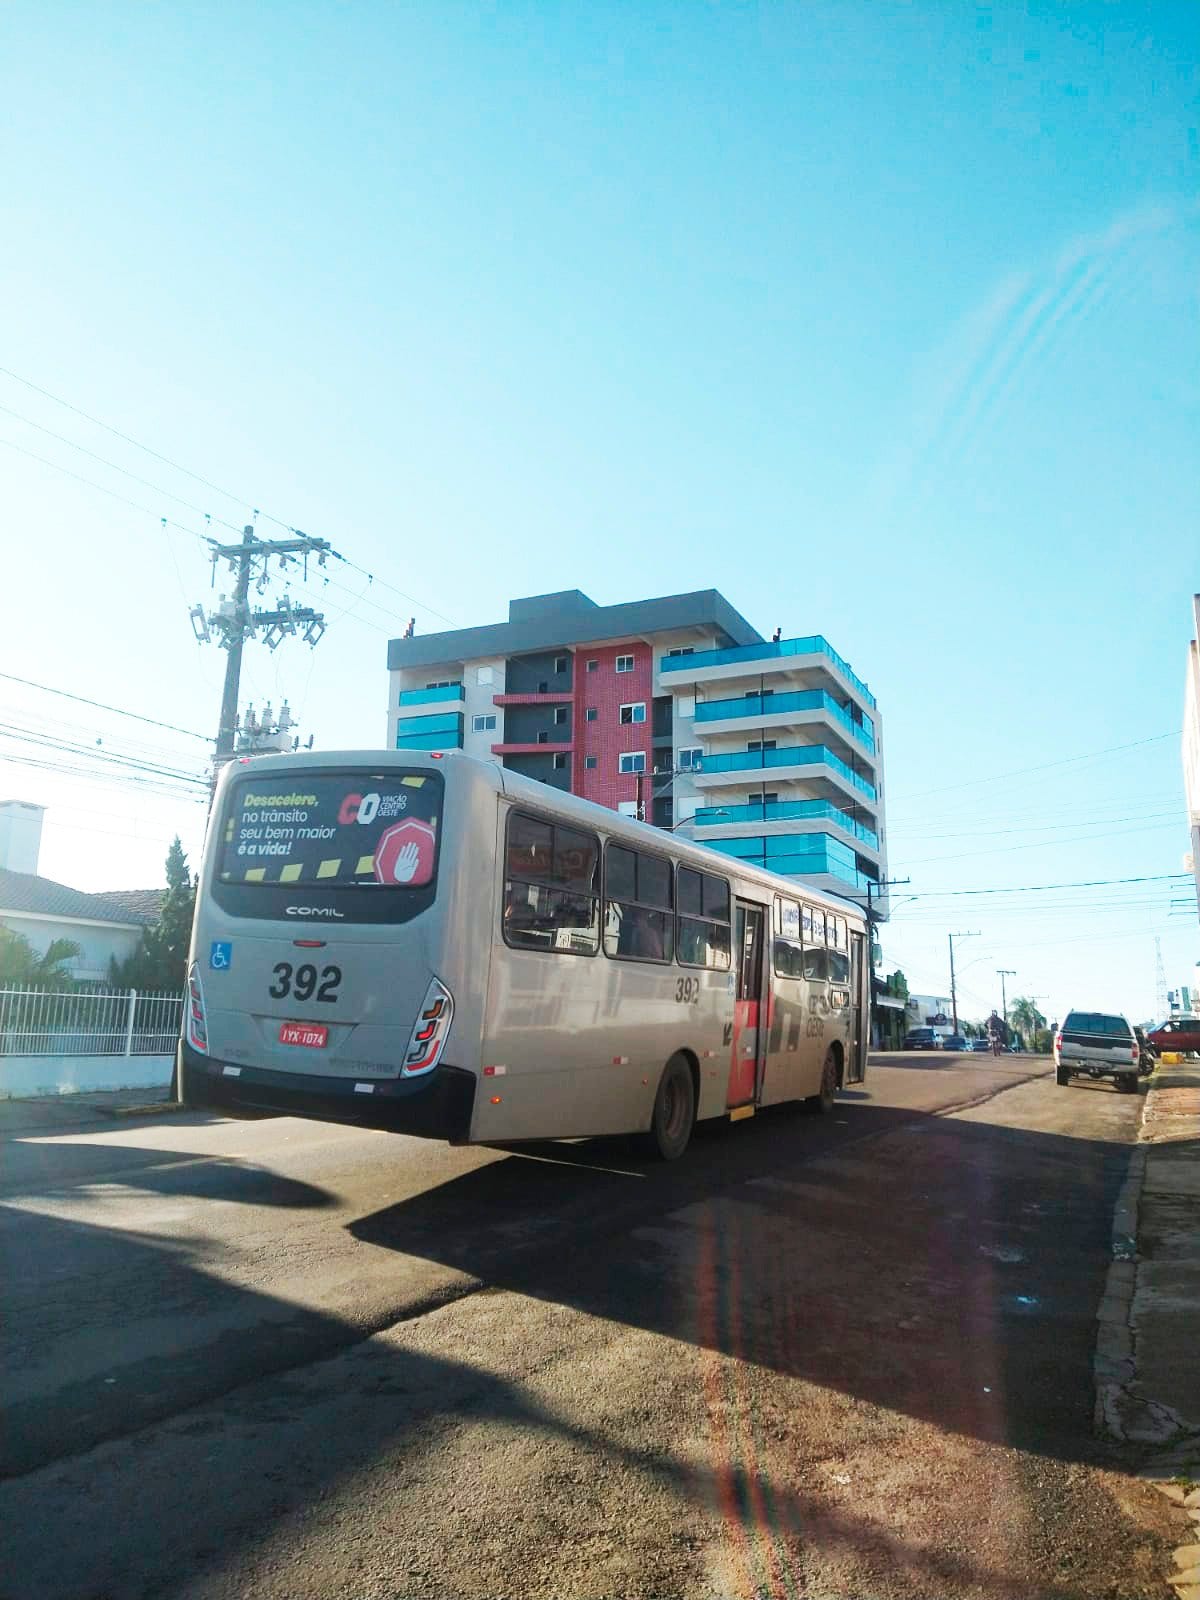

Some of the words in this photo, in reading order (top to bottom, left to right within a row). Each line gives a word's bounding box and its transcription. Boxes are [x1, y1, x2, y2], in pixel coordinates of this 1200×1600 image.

[243, 793, 319, 808] Desacelere,
[380, 801, 407, 811] CENTRO
[242, 811, 259, 823] no
[261, 808, 308, 823] trânsito
[377, 809, 398, 817] OESTE
[240, 828, 263, 840] seu
[265, 826, 293, 840] bem
[296, 824, 336, 840] maior
[238, 841, 246, 856] é
[247, 845, 257, 856] a
[258, 841, 292, 856] vida!
[285, 905, 344, 918] COMIL
[269, 962, 342, 1003] 392
[675, 977, 700, 1004] 392
